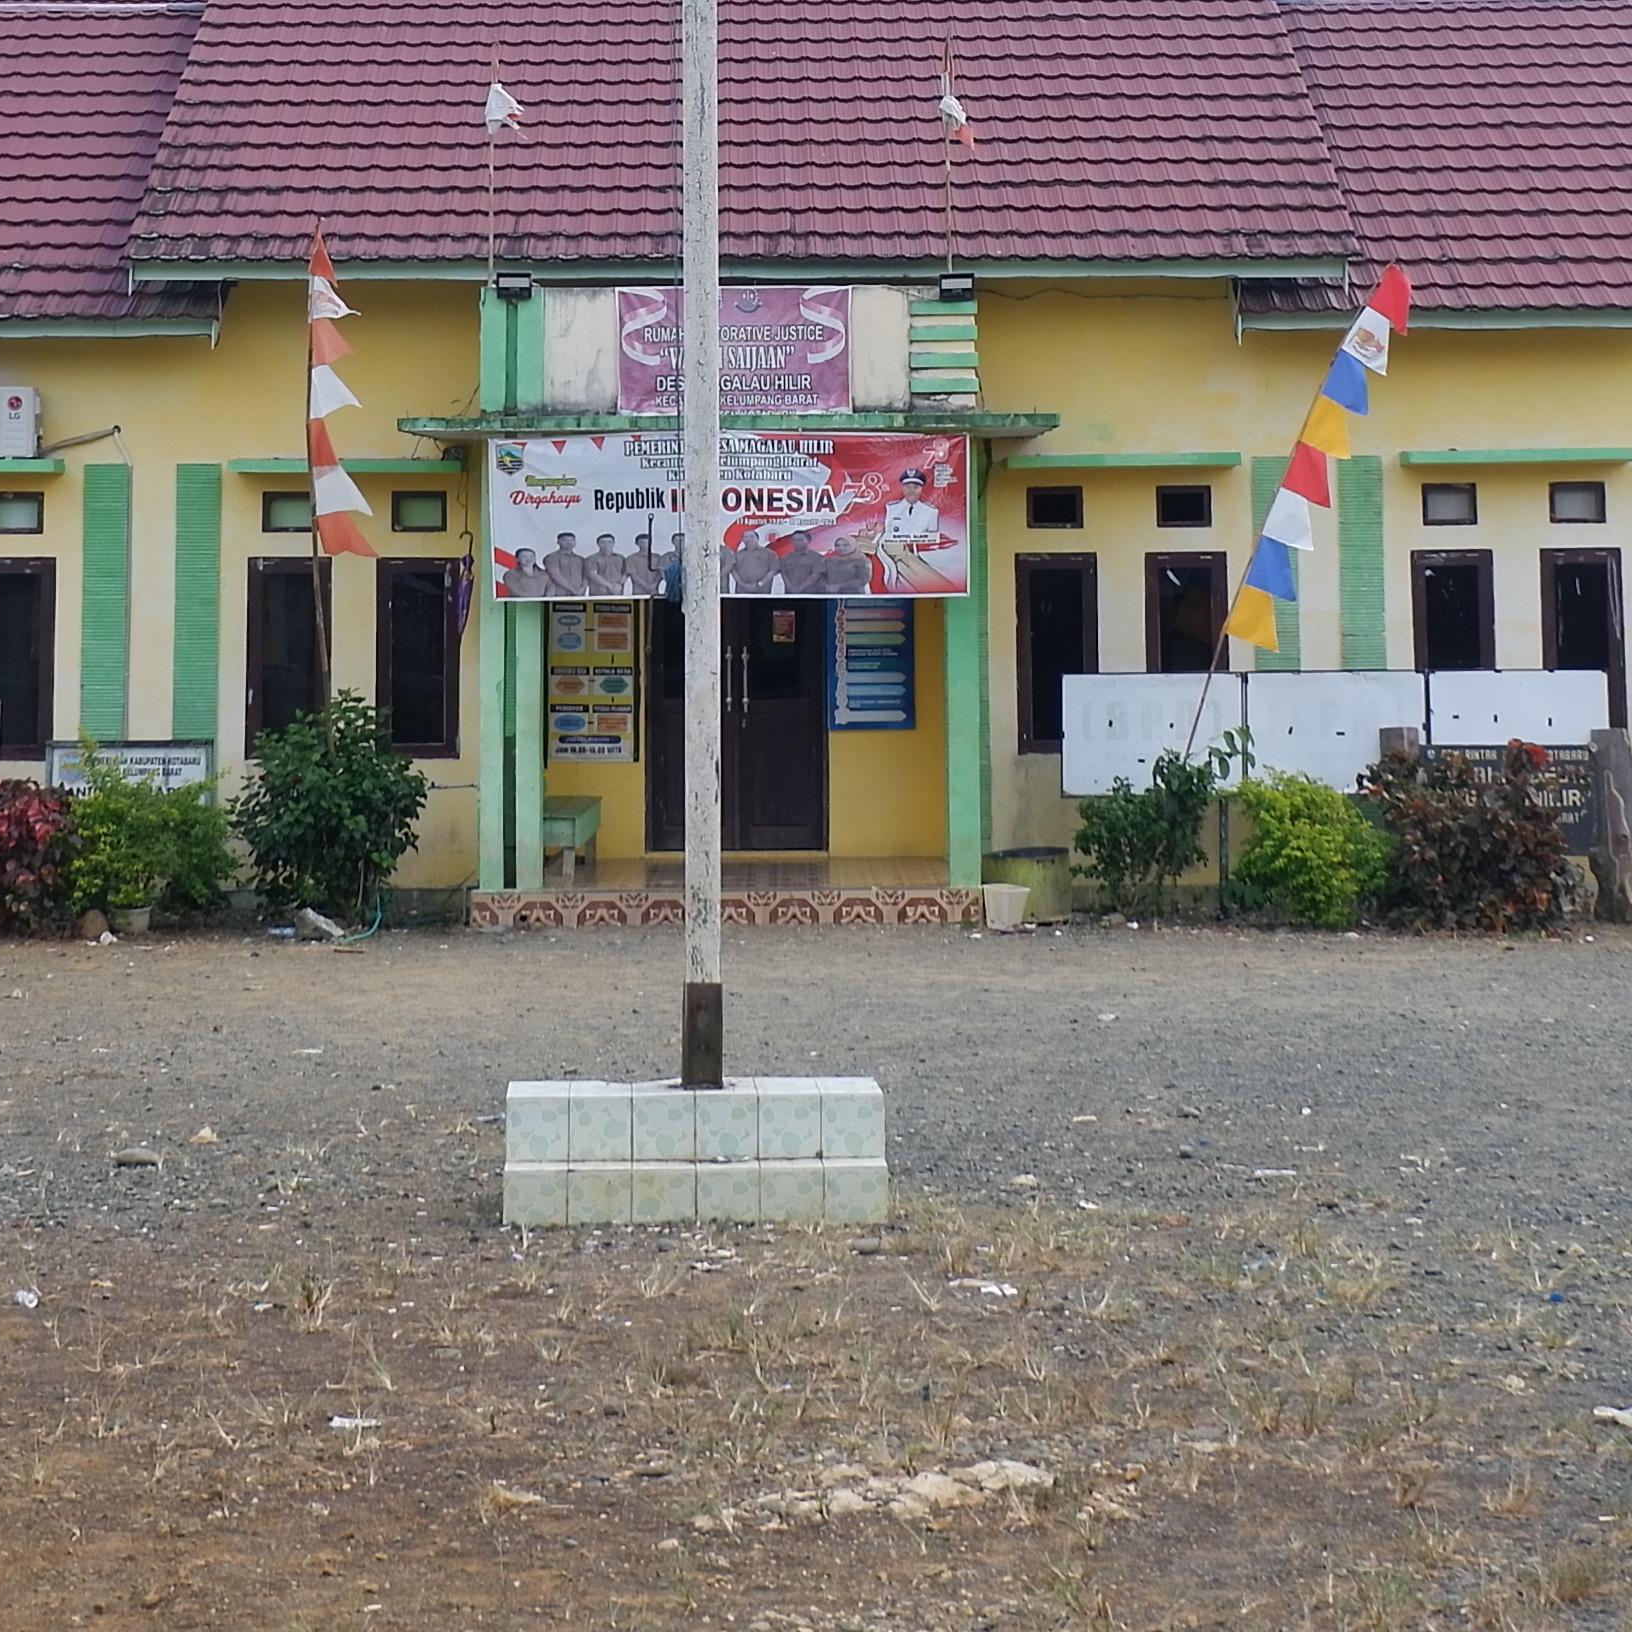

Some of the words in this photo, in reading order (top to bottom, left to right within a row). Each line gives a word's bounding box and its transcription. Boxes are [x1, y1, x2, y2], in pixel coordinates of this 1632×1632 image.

[719, 325, 771, 341] ORATIVE
[774, 325, 824, 341] JUSTICE
[656, 375, 685, 392] DES
[719, 375, 771, 391] GALAU
[773, 374, 812, 390] HILIR
[720, 394, 782, 406] KELUMPANG
[784, 394, 819, 405] BARAT
[8, 411, 21, 420] LG
[739, 439, 797, 455] MAGALAU
[799, 439, 834, 455] HILIR
[719, 456, 781, 468] elumpang
[783, 456, 819, 468] Barat
[735, 469, 793, 481] Kotabaru
[509, 490, 582, 509] Dirgahayu
[594, 487, 666, 513] Republik
[671, 487, 836, 512] IONESIA
